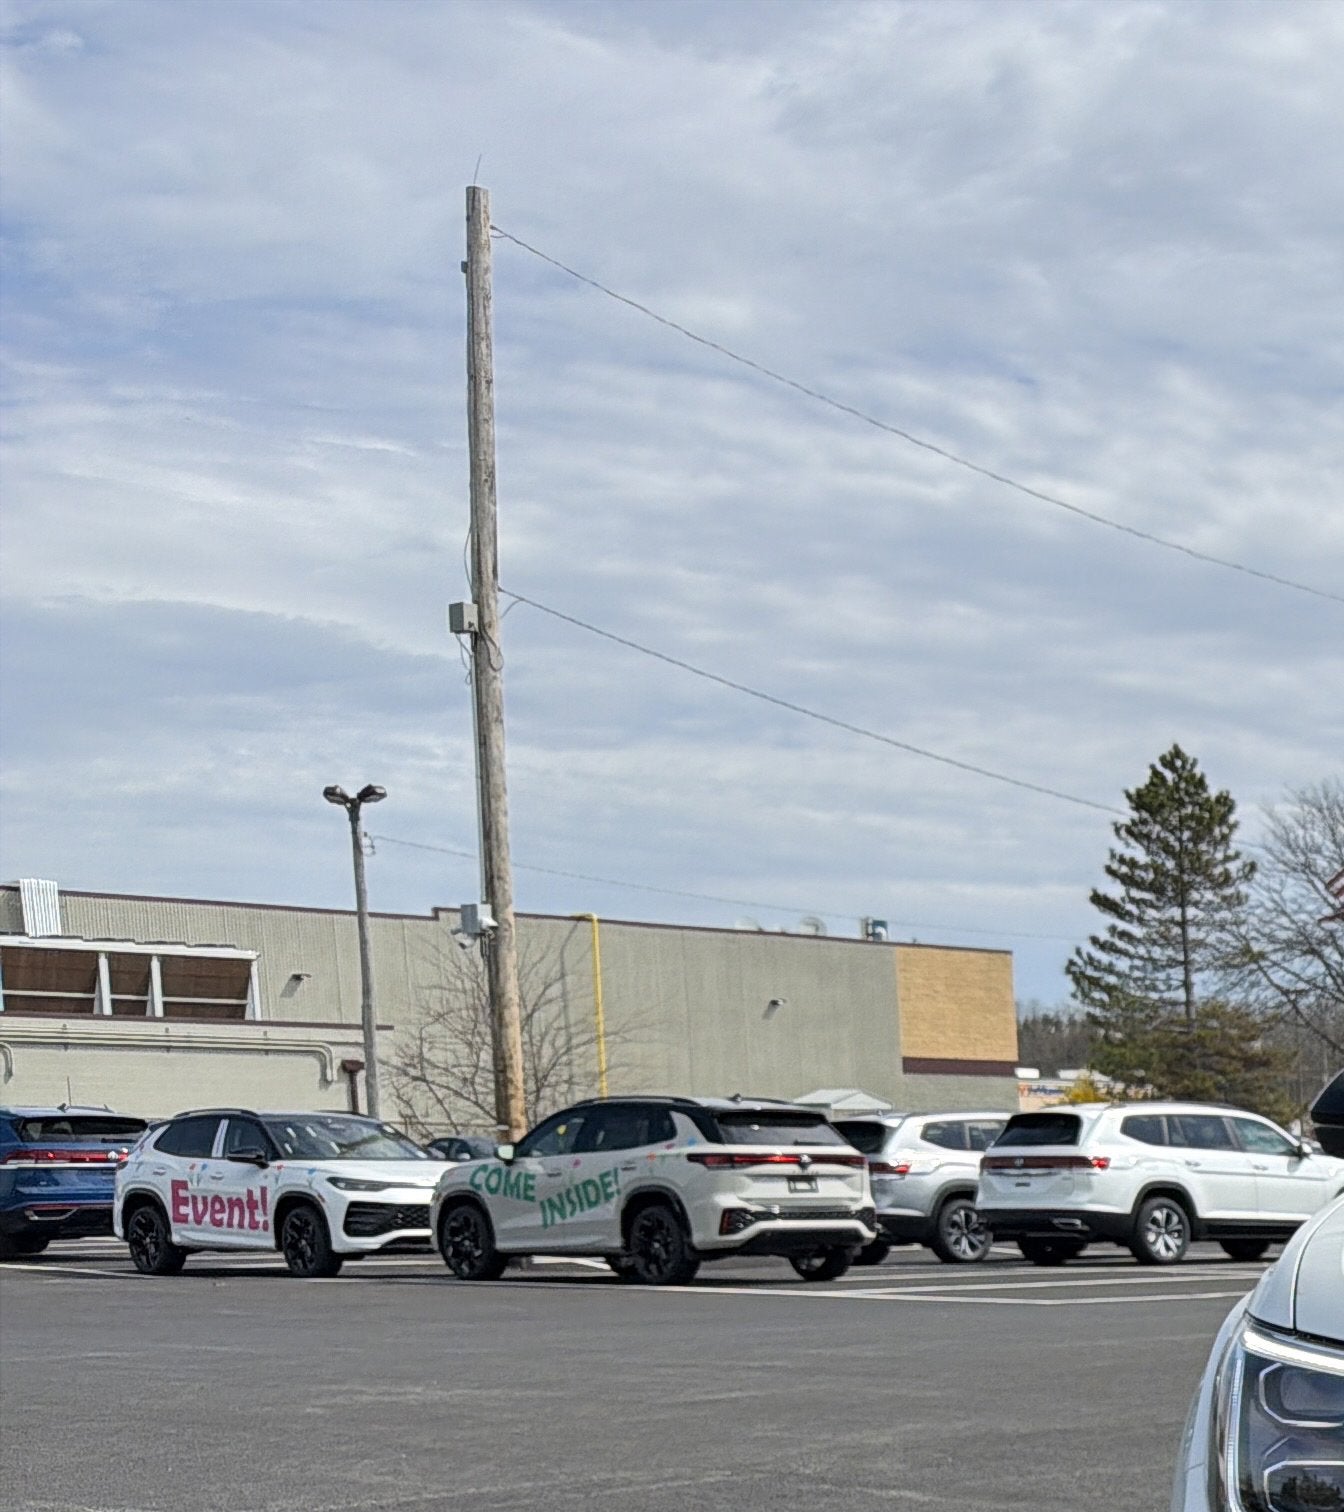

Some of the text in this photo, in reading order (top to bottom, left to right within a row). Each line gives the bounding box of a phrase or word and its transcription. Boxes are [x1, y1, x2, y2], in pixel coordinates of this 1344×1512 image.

[171, 1179, 270, 1232] Event!
[469, 1164, 536, 1202] COME
[539, 1167, 622, 1229] INSIDE!
